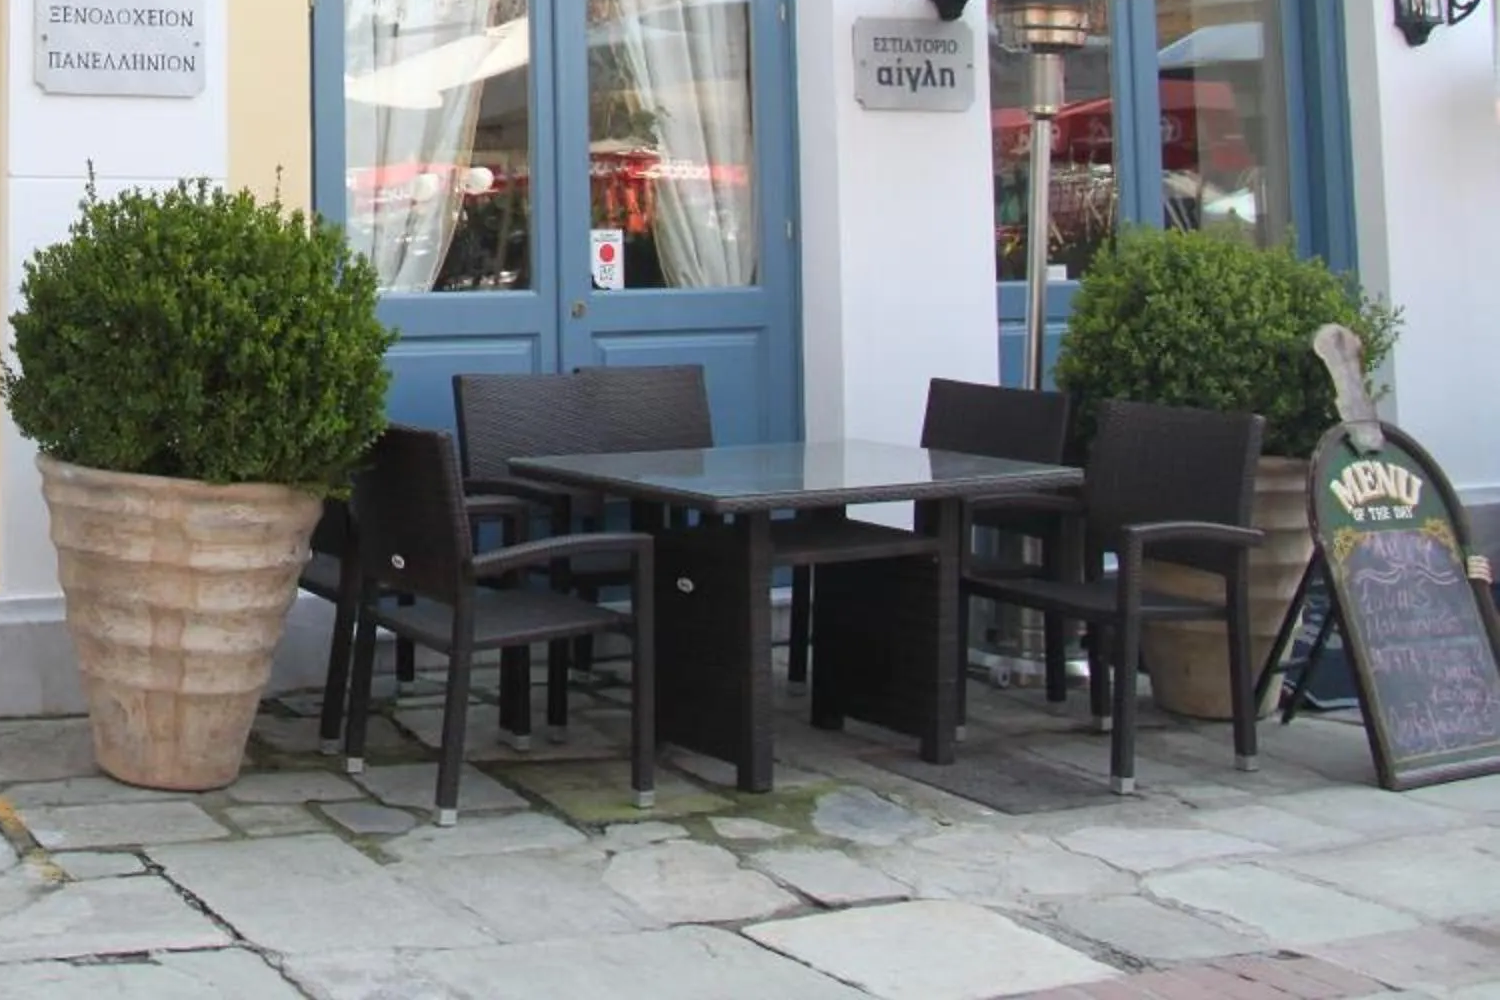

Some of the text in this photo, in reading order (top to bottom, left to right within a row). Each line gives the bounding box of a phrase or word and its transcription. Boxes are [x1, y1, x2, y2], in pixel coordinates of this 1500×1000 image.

[48, 6, 194, 27] ΞΕΝΟΔΟΧΕΙΟΝ
[873, 37, 959, 55] ΕΣΤΙΑΤΟΡΙΟ
[48, 51, 196, 73] ΠΑΝΕΛΛΗΝΙΟΝ
[1329, 459, 1423, 514] MENU
[1367, 504, 1391, 521] THE
